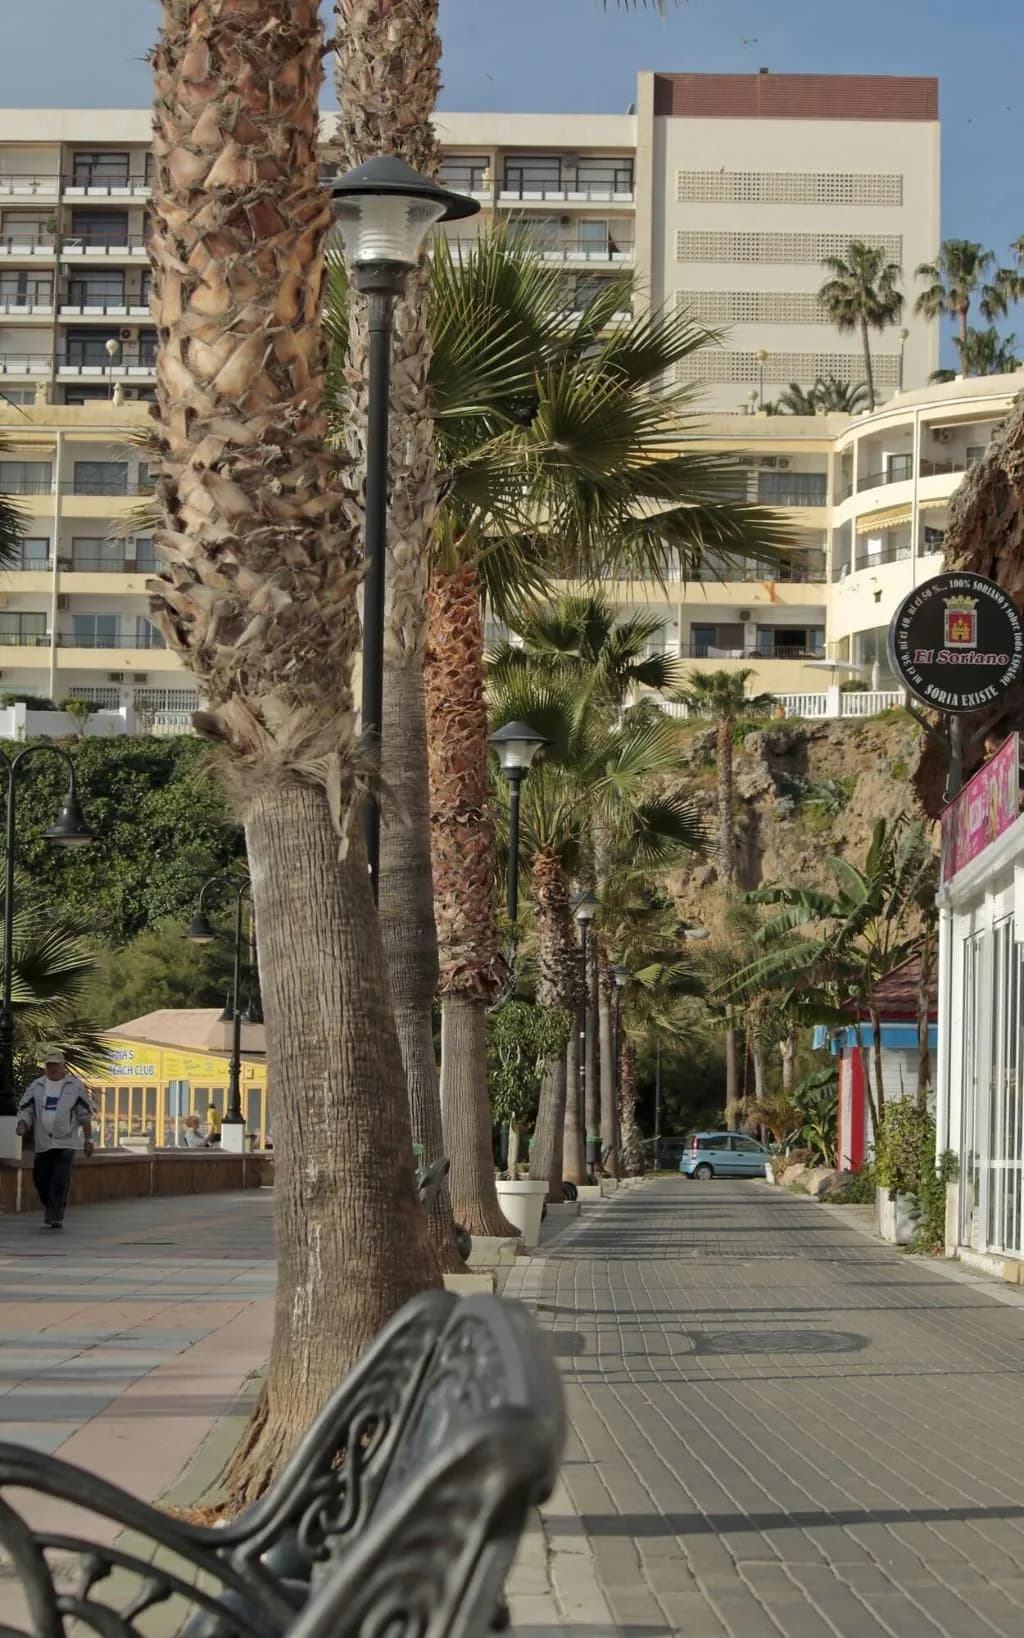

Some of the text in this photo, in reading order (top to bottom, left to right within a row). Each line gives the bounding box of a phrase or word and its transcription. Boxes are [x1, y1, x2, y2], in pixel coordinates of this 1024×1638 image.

[949, 579, 970, 589] 100%
[972, 581, 1005, 604] SORIANO
[914, 649, 1009, 665] El Soriano
[924, 683, 999, 707] SORIA EXISTE
[135, 1065, 154, 1076] CLUB
